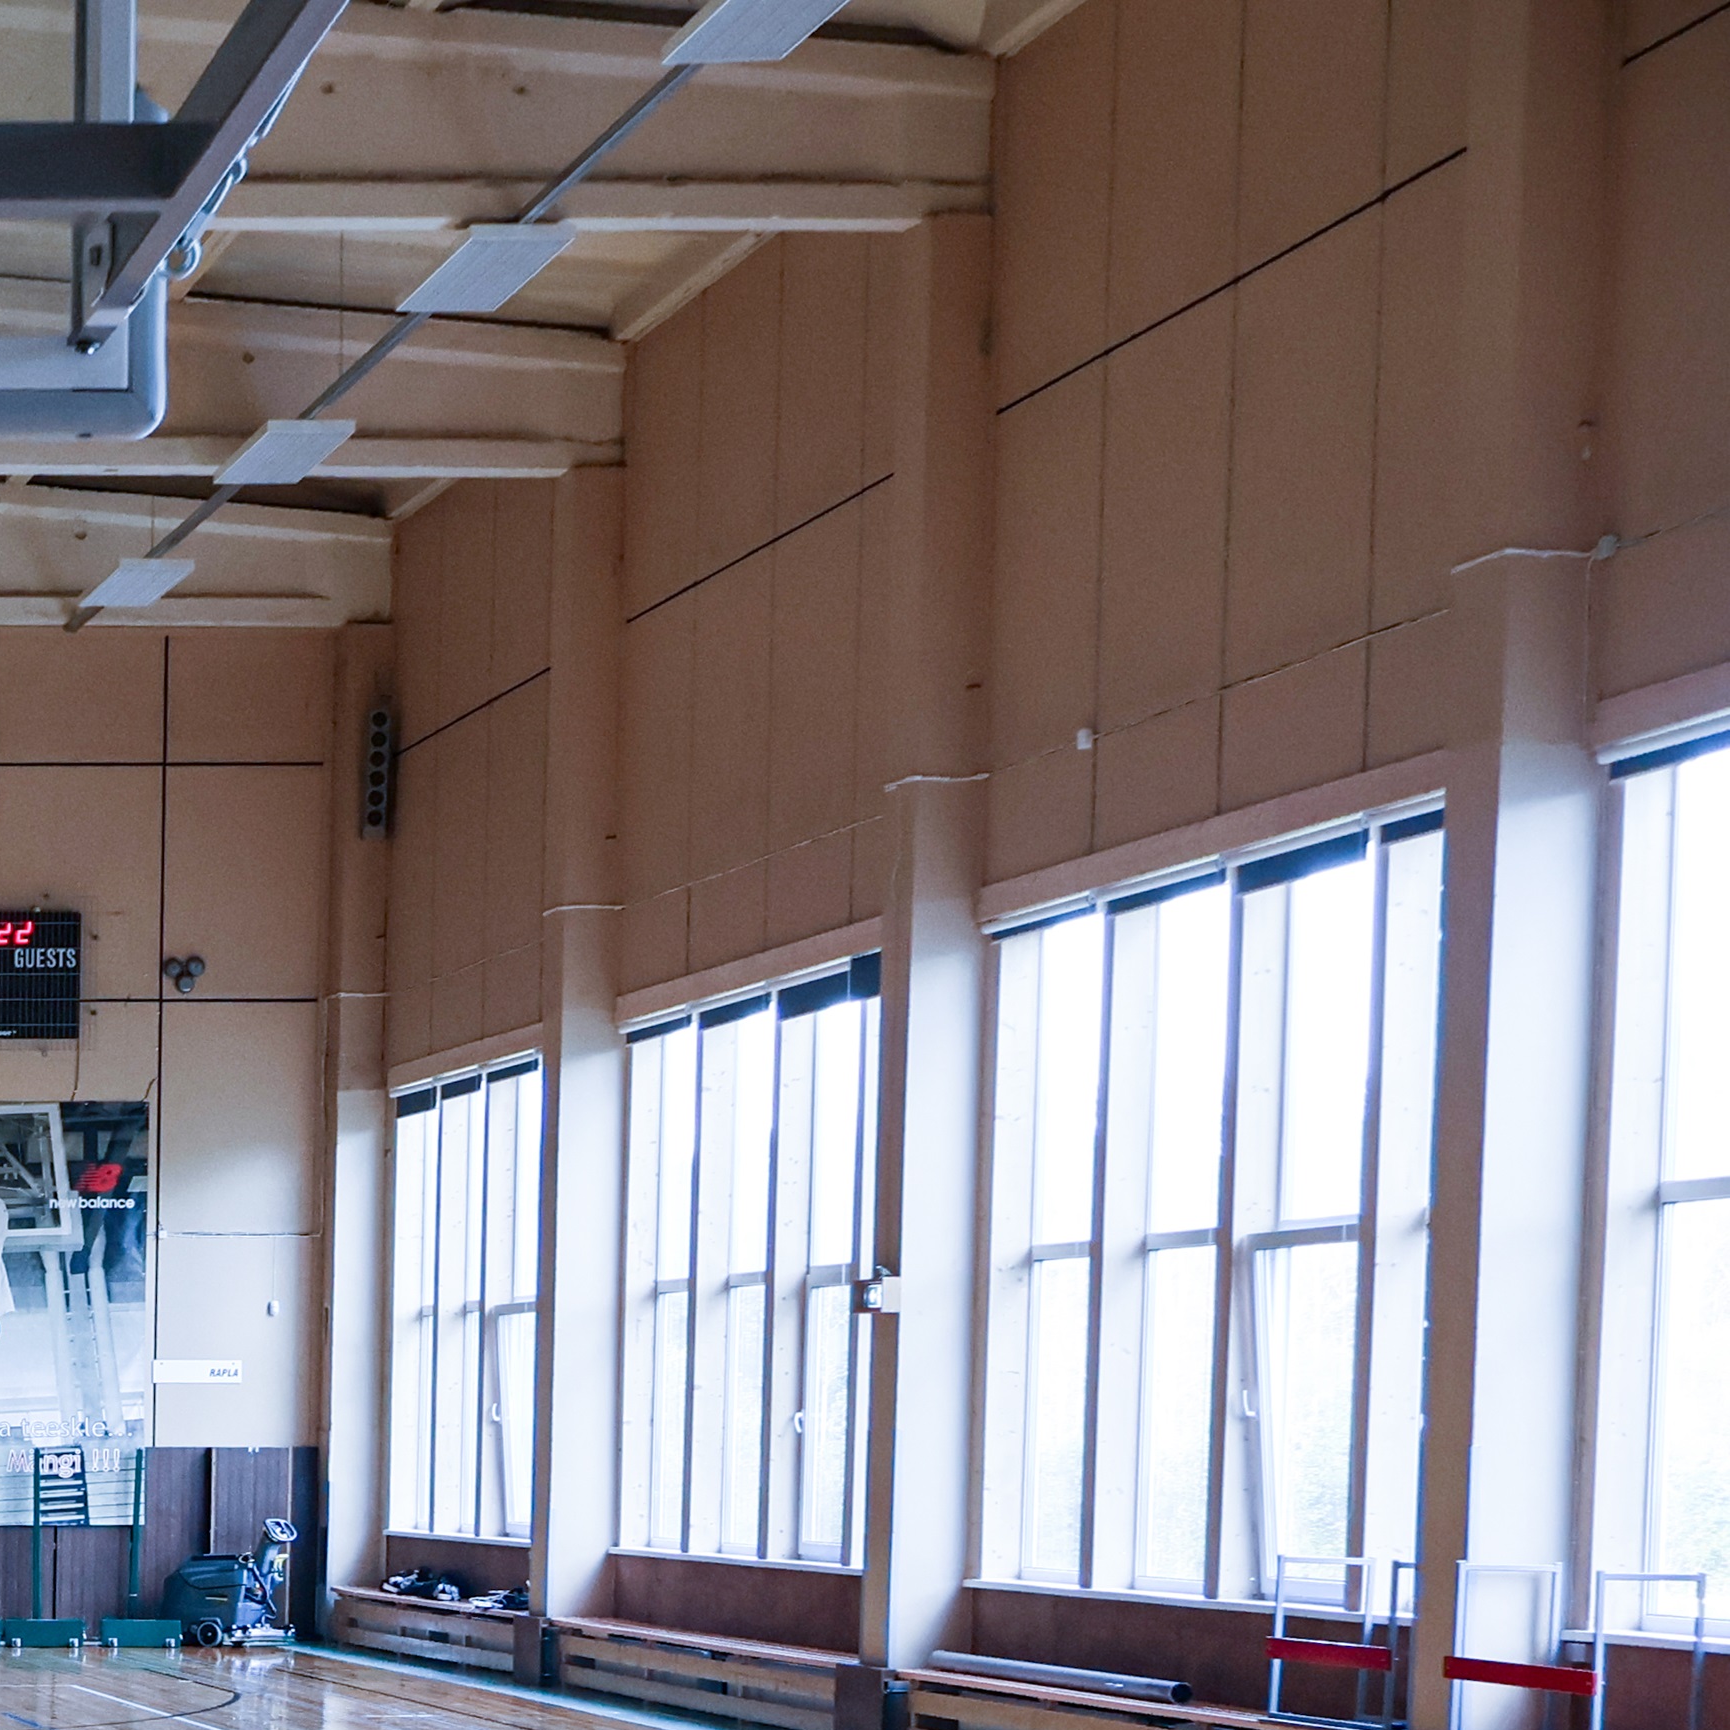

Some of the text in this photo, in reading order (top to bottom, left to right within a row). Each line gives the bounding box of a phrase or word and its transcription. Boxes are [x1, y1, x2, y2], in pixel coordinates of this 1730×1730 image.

[14, 948, 77, 968] GUESTS
[49, 1196, 136, 1209] new balance
[209, 1368, 239, 1377] RAPLA
